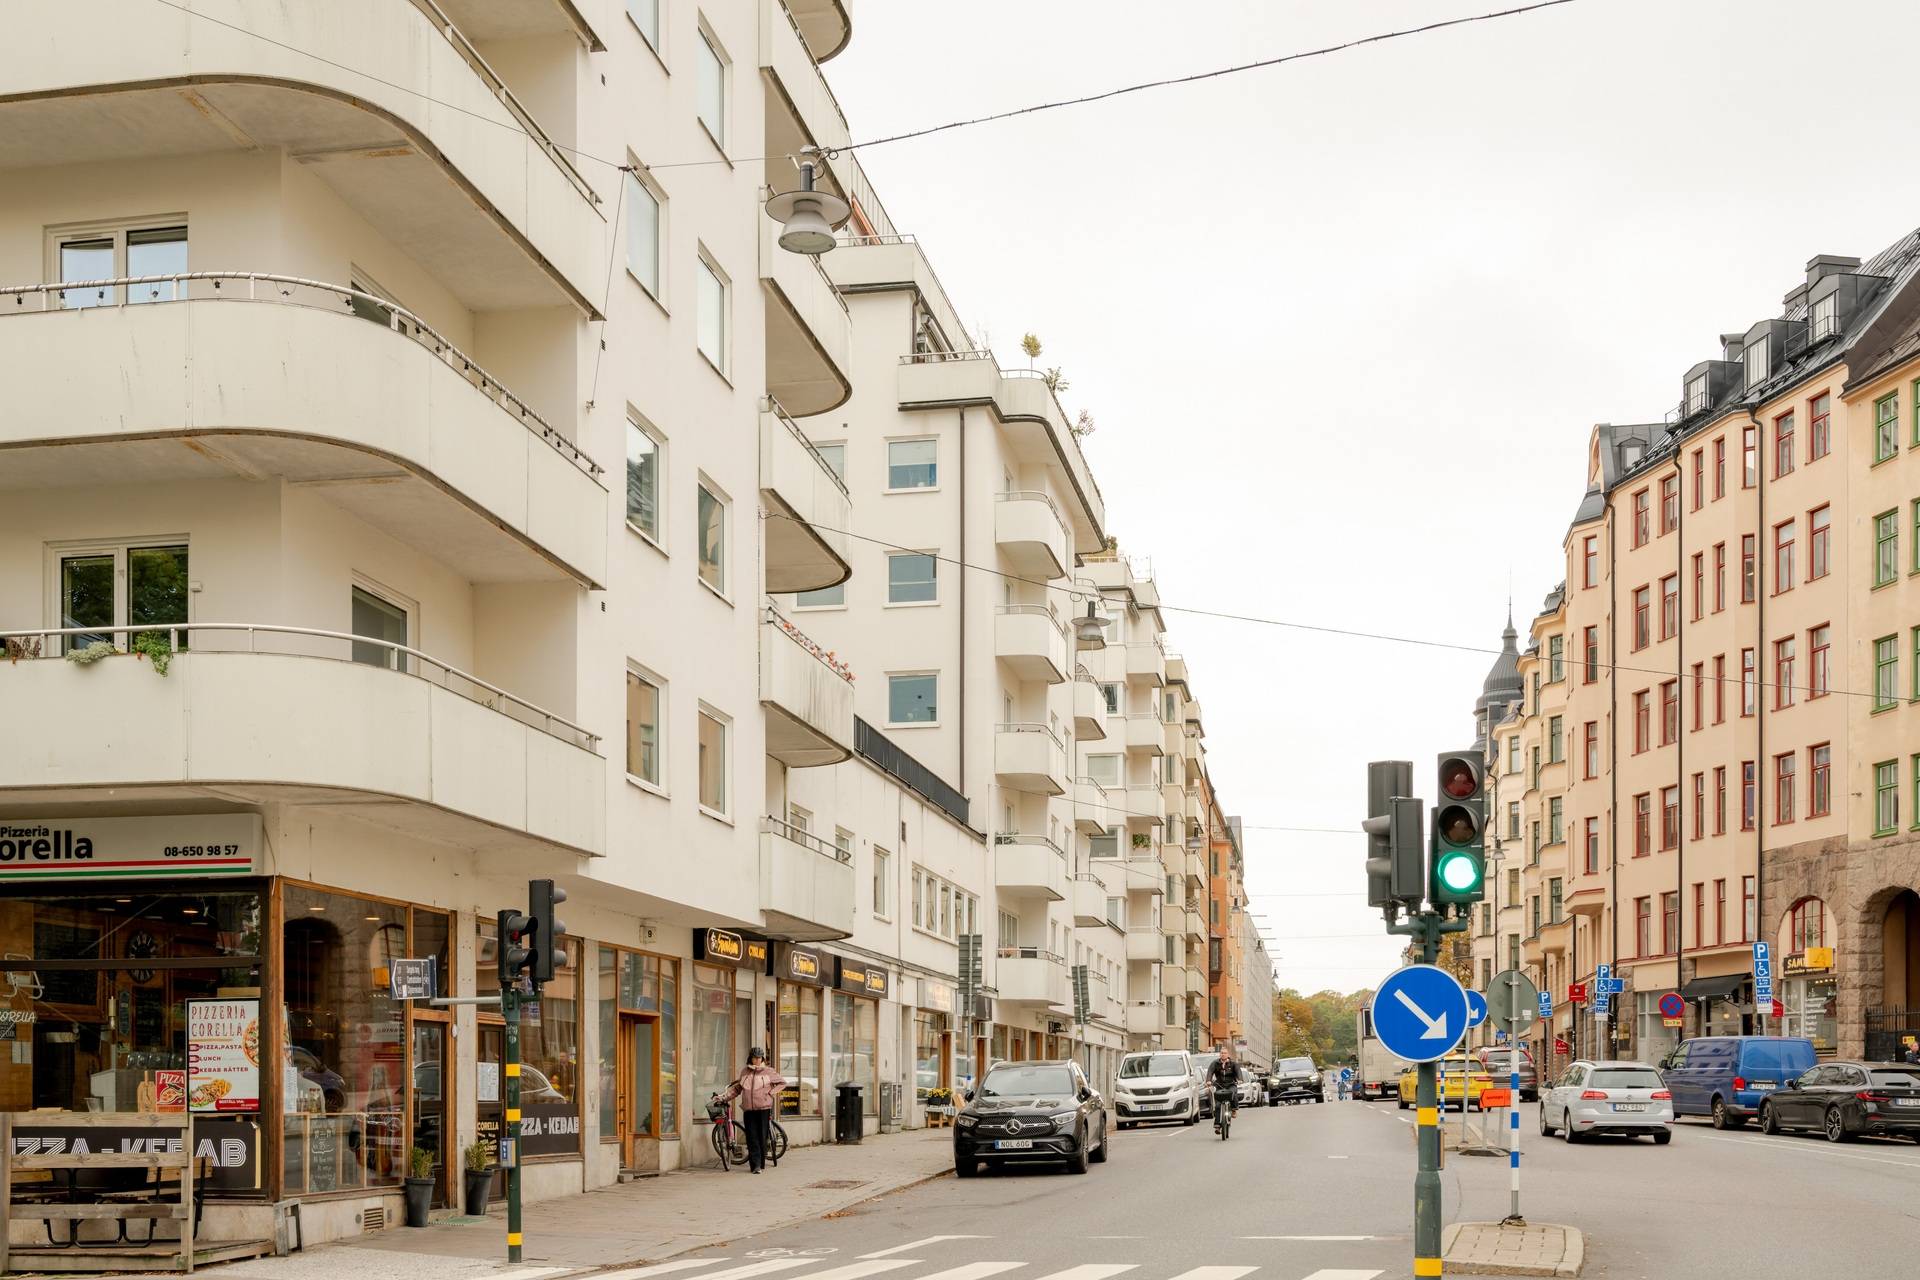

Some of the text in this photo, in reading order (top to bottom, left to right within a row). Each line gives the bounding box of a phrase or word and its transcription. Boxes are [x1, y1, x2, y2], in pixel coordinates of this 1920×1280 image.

[0, 825, 50, 838] Pizzeria
[164, 844, 239, 857] 08-650 98 57
[0, 1010, 37, 1023] ORELLA
[191, 1005, 246, 1020] PIZZERIA
[191, 1022, 243, 1037] CORELLA
[159, 1071, 185, 1085] PIZZA
